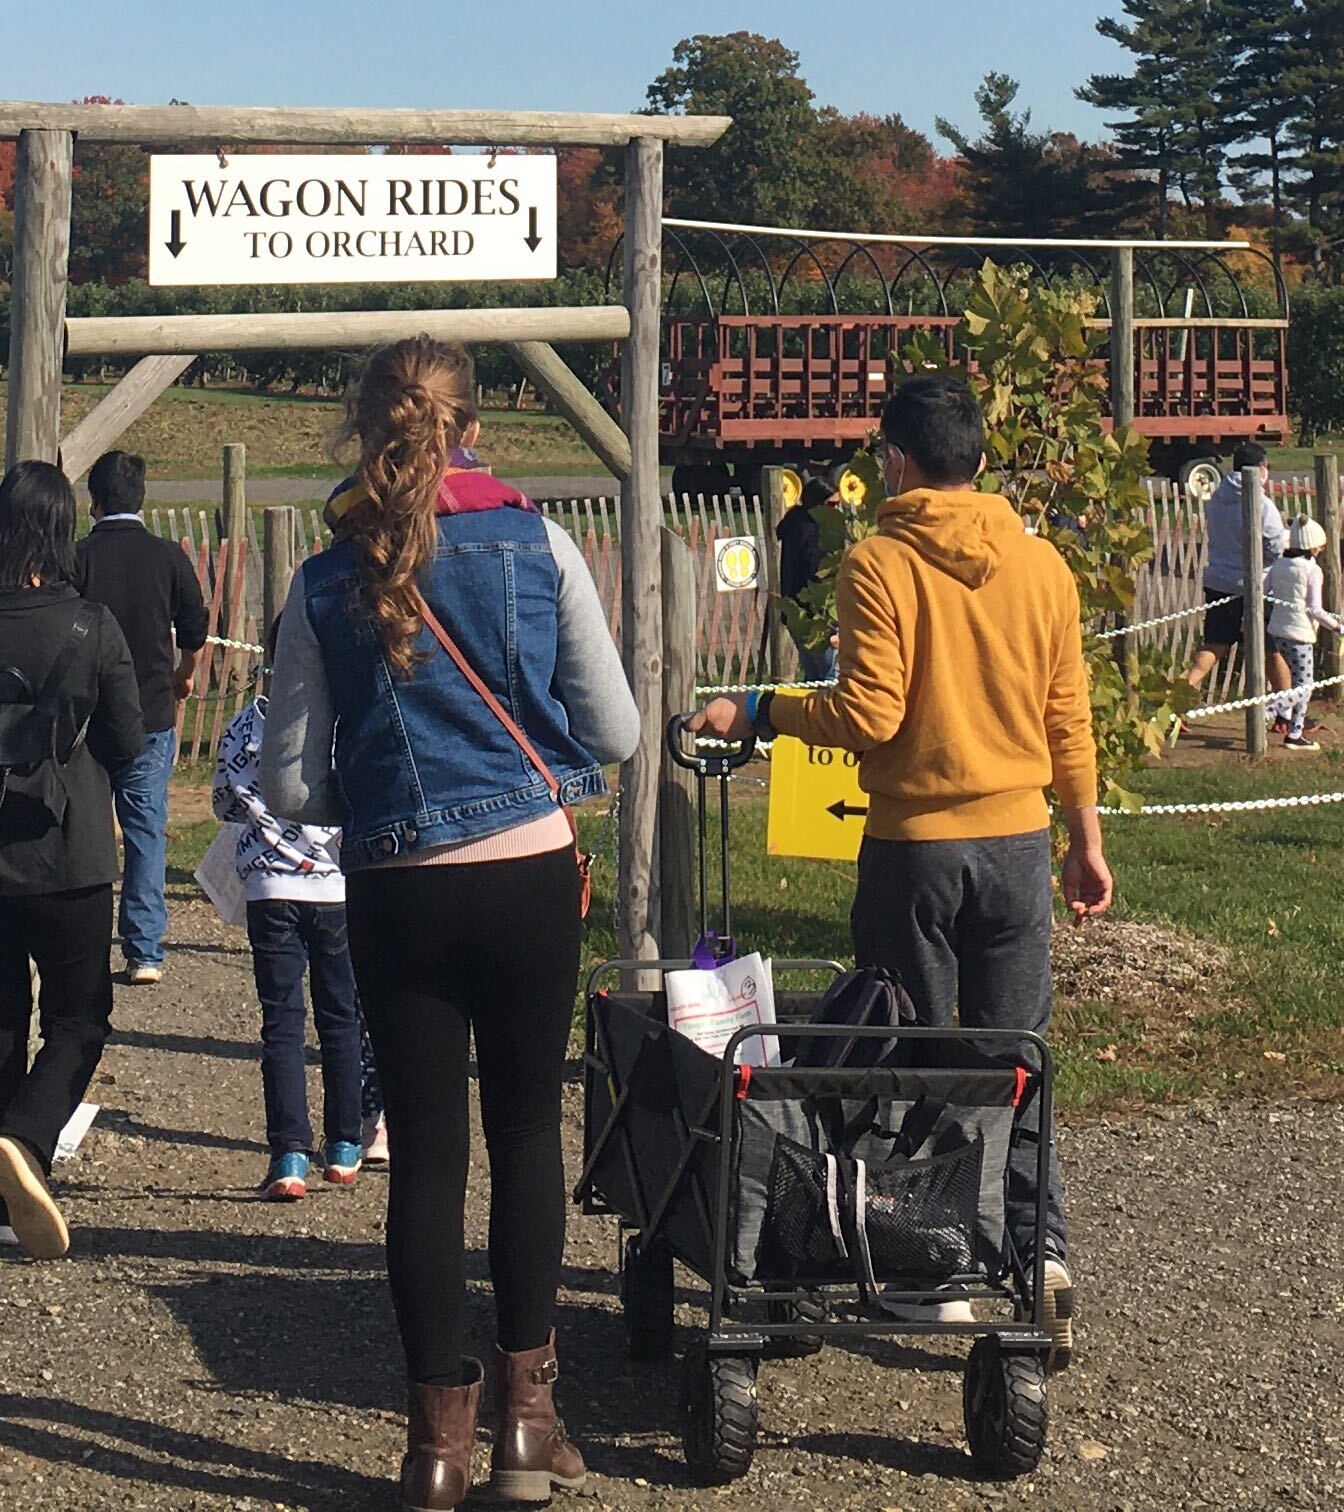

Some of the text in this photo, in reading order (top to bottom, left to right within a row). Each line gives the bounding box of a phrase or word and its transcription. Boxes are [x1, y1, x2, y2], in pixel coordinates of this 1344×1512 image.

[181, 178, 520, 218] WAGON RIDES
[244, 230, 475, 259] TO ORCHARD
[808, 744, 833, 766] to
